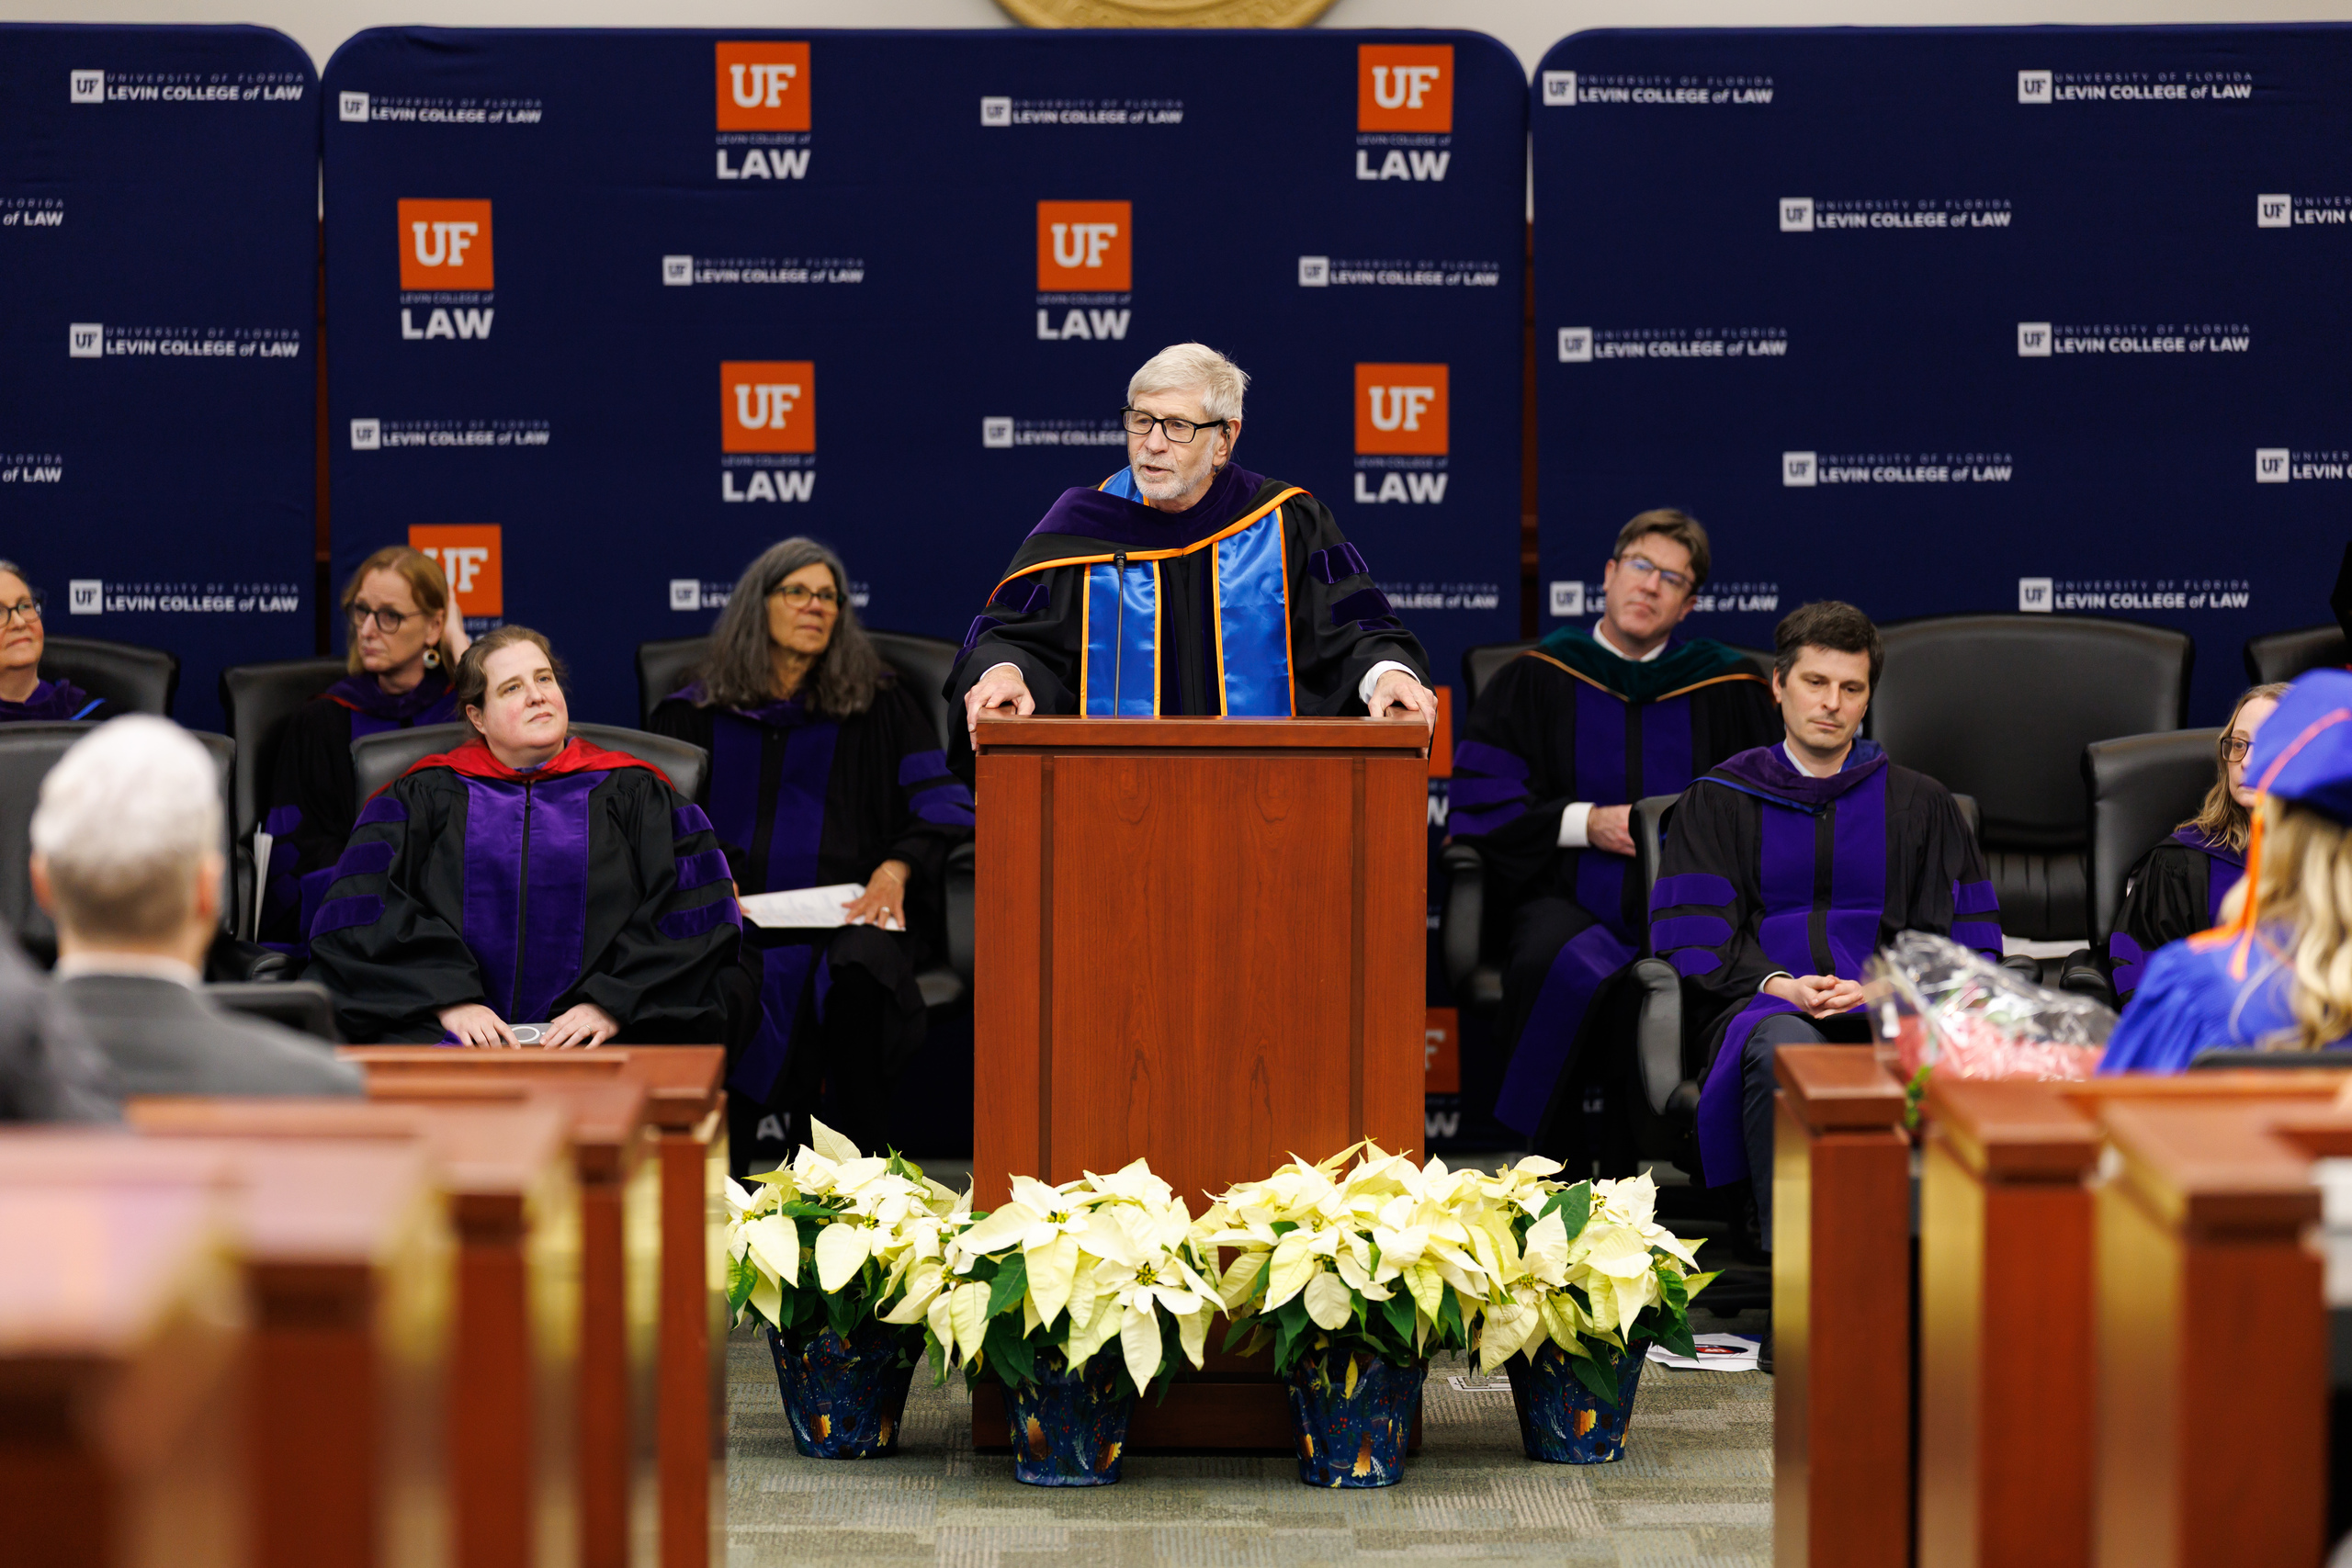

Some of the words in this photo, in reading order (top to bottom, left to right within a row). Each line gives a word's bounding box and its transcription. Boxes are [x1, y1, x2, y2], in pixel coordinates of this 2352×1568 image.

[107, 73, 200, 83] UNIVERSITY
[730, 64, 796, 107] UF
[1578, 75, 1671, 86] UNIVERSITY
[2054, 73, 2148, 83] UNIVERSITY
[107, 85, 158, 100] LEVIN
[163, 85, 239, 100] COLLEGE
[243, 85, 260, 100] of
[264, 85, 303, 100] LAW
[1373, 66, 1439, 108] UF
[1578, 87, 1630, 102] LEVIN
[1632, 88, 1709, 103] COLLEGE
[1712, 89, 1730, 103] of
[1733, 89, 1773, 103] LAW
[2055, 85, 2106, 100] LEVIN
[2109, 85, 2187, 99] COLLEGE
[2190, 85, 2208, 99] of
[2211, 85, 2251, 98] LAW
[371, 107, 416, 120] LEVIN
[418, 108, 486, 122] COLLEGE
[506, 110, 541, 123] LAW
[1012, 110, 1058, 123] LEVIN
[1058, 110, 1127, 123] COLLEGE
[1148, 110, 1182, 123] LAW
[717, 150, 810, 179] LAW
[1357, 151, 1450, 181] LAW
[1815, 200, 1909, 210] UNIVERSITY
[3, 211, 19, 225] of
[24, 211, 63, 226] LAW
[1816, 213, 1867, 228] LEVIN
[1871, 212, 1947, 228] COLLEGE
[1951, 212, 1968, 227] of
[1972, 212, 2011, 227] LAW
[2295, 209, 2346, 223] LEVIN
[413, 222, 478, 265] UF
[1052, 224, 1117, 267] UF
[694, 269, 740, 283] LEVIN
[741, 269, 808, 283] COLLEGE
[829, 269, 864, 283] LAW
[1329, 270, 1375, 284] LEVIN
[1375, 271, 1443, 285] COLLEGE
[1464, 273, 1498, 286] LAW
[401, 309, 493, 339] LAW
[1037, 310, 1130, 339] LAW
[2054, 325, 2147, 335] UNIVERSITY
[105, 328, 198, 339] UNIVERSITY
[1594, 330, 1686, 342] UNIVERSITY
[106, 340, 156, 355] LEVIN
[160, 340, 235, 355] COLLEGE
[239, 342, 256, 356] of
[260, 342, 299, 356] LAW
[1594, 343, 1645, 358] LEVIN
[1647, 341, 1724, 356] COLLEGE
[1726, 341, 1745, 356] of
[1747, 341, 1787, 355] LAW
[2054, 338, 2105, 353] LEVIN
[2109, 337, 2185, 353] COLLEGE
[2188, 337, 2206, 352] of
[2210, 337, 2249, 352] LAW
[735, 385, 800, 429] UF
[1369, 387, 1434, 431] UF
[380, 432, 426, 446] LEVIN
[428, 432, 494, 446] COLLEGE
[514, 431, 549, 445] LAW
[1013, 431, 1061, 445] LEVIN
[1818, 454, 1911, 466] UNIVERSITY
[3, 467, 18, 481] of
[23, 468, 62, 482] LAW
[1819, 468, 1870, 482] LEVIN
[1872, 467, 1948, 482] COLLEGE
[1951, 467, 1969, 481] of
[1973, 466, 2012, 481] LAW
[2293, 464, 2343, 479] LEVIN
[723, 471, 815, 502] LAW
[1355, 473, 1447, 503] LAW
[105, 583, 198, 593] UNIVERSITY
[2054, 581, 2147, 592] UNIVERSITY
[106, 596, 155, 611] LEVIN
[159, 596, 234, 612] COLLEGE
[239, 596, 255, 612] of
[259, 596, 298, 612] LAW
[1464, 595, 1498, 608] LAW
[1738, 595, 1778, 611] LAW
[2055, 593, 2106, 609] LEVIN
[2109, 593, 2185, 608] COLLEGE
[2189, 593, 2206, 608] of
[2210, 592, 2249, 608] LAW
